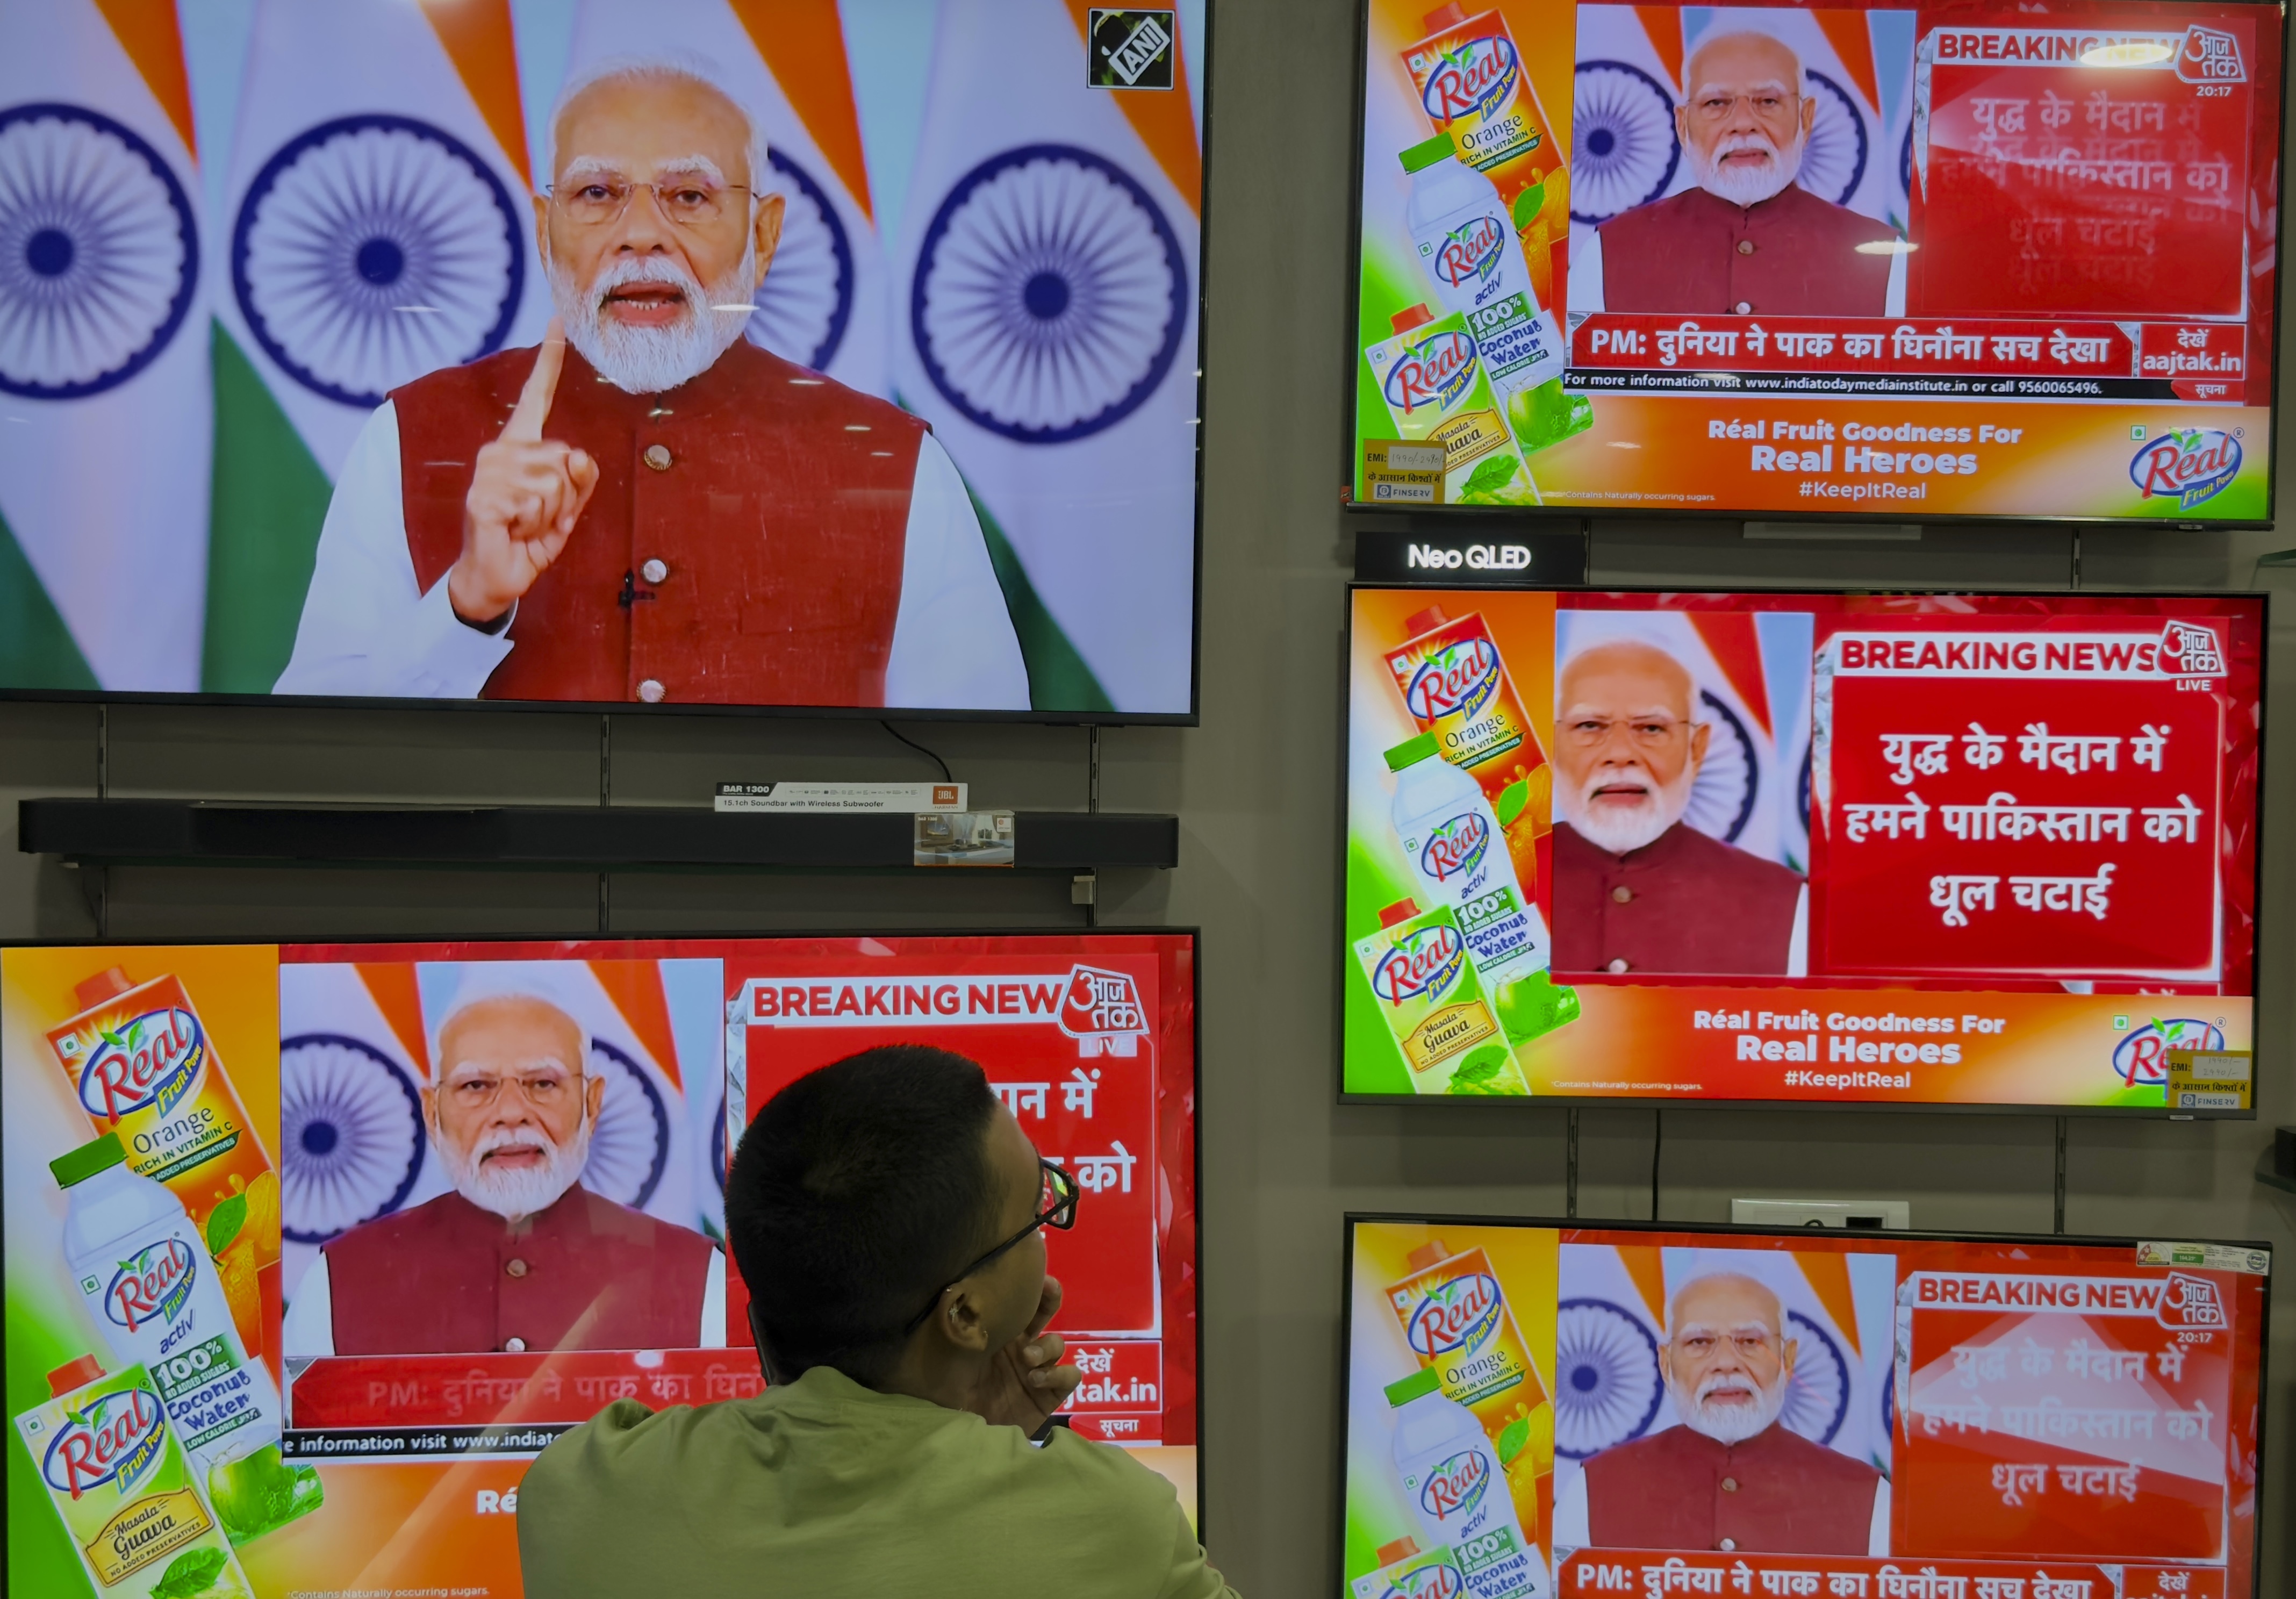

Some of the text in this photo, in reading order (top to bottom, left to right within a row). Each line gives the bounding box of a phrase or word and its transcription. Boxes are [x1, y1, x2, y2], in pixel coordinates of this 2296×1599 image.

[1123, 25, 1163, 73] ANI
[1939, 34, 2099, 61] BREAKING
[2185, 31, 2229, 61] आज
[1435, 35, 1508, 128] Real
[2202, 55, 2238, 76] तक
[2196, 86, 2232, 96] 20:17
[1461, 114, 1523, 150] Orange
[1970, 91, 2166, 140] युद्ध मैदान
[1461, 153, 1482, 166] RICH
[1483, 147, 1493, 157] IN
[1495, 131, 1529, 151] VITAMIN
[1477, 139, 1538, 171] ADDED PRESERVATIVES
[2019, 148, 2232, 190] पाकिस्तान को
[1444, 216, 1496, 288] Real
[1475, 270, 1502, 305] activ
[1472, 296, 1522, 332] 100%
[1478, 319, 1542, 356] Coconut
[1490, 337, 1540, 365] Water
[1591, 322, 2110, 365] PM: दुनिया ने पाक का घिनौना सच देखा
[2177, 328, 2210, 348] देखें
[1397, 330, 1467, 415] Real
[2143, 352, 2242, 375] aajtak.in
[1565, 373, 2102, 394] For more information visit www.indiatodaymediainstitute.in or call 9560065496.
[2195, 383, 2226, 399] सूचना
[1436, 420, 1469, 441] Masala
[1709, 419, 2022, 444] Réal Fruit Goodness For
[1367, 453, 1387, 462] EMI:
[1752, 444, 1977, 475] Real Heroes
[2142, 433, 2234, 500] Real
[1368, 472, 1376, 481] के
[1379, 474, 1405, 482] आसान
[1408, 473, 1433, 483] किश्तों
[1393, 489, 1430, 497] FINSERV
[1799, 482, 1926, 500] #KeepItReal
[1605, 492, 1642, 500] Naturally
[1644, 493, 1684, 501] occurring
[1409, 544, 1531, 569] Neo QLED
[1841, 641, 2157, 672] BREAKING NEWS
[1418, 637, 1489, 726] Real
[2177, 679, 2210, 691] LIVE
[1445, 714, 1505, 748] Orange
[1445, 729, 1511, 763] RICH IN VITAMIN
[1879, 723, 2172, 785] युद्ध के मैदान में
[723, 785, 743, 793] BAR
[938, 790, 954, 800] JBL
[1843, 792, 2202, 842] हमने पाकिस्तान को
[1430, 812, 1481, 883] Real
[1929, 864, 2118, 926] धूल चटाई
[1385, 924, 1453, 1008] Real
[754, 985, 961, 1017] BREAKING
[1424, 1020, 1470, 1053] Guava
[1694, 1010, 2005, 1034] Réal Fruit Goodness For
[1088, 1038, 1128, 1054] LIVE
[1737, 1035, 1961, 1064] Real Heroes
[95, 1007, 189, 1127] Real
[1785, 1071, 1910, 1089] #KeepItReal
[2171, 1063, 2191, 1071] EMI:
[1061, 1067, 1100, 1118] में
[1592, 1081, 1629, 1089] Naturally
[1632, 1082, 1671, 1091] occurring
[2172, 1081, 2180, 1089] के
[2183, 1082, 2210, 1091] आसान
[133, 1107, 214, 1154] Orange
[162, 1122, 233, 1163] IN VITAMIN C
[1074, 1141, 1137, 1192] को
[116, 1238, 185, 1333] Real
[1919, 1278, 2079, 1307] BREAKING
[1420, 1272, 1491, 1362] Real
[2177, 1332, 2212, 1342] 20:17
[157, 1341, 223, 1388] 100%
[1074, 1348, 1115, 1374] देखें
[1446, 1350, 1507, 1384] Orange
[2067, 1339, 2189, 1382] मैदान में
[1445, 1365, 1512, 1399] RICH IN VITAMIN
[1100, 1419, 1139, 1438] सूचना
[2165, 1401, 2213, 1441] को
[58, 1387, 151, 1501] Real
[300, 1435, 405, 1453] information
[411, 1434, 447, 1450] visit
[1429, 1450, 1482, 1521] Real
[1992, 1458, 2140, 1505] धूल चटाई
[113, 1514, 177, 1560] Guava
[114, 1505, 160, 1536] Masala
[110, 1522, 201, 1577] NO PRESERVATIVES
[395, 1587, 490, 1598] occurring sugars.
[1577, 1560, 1868, 1596] PM: ने पाक का
[2158, 1571, 2190, 1591] देखें
